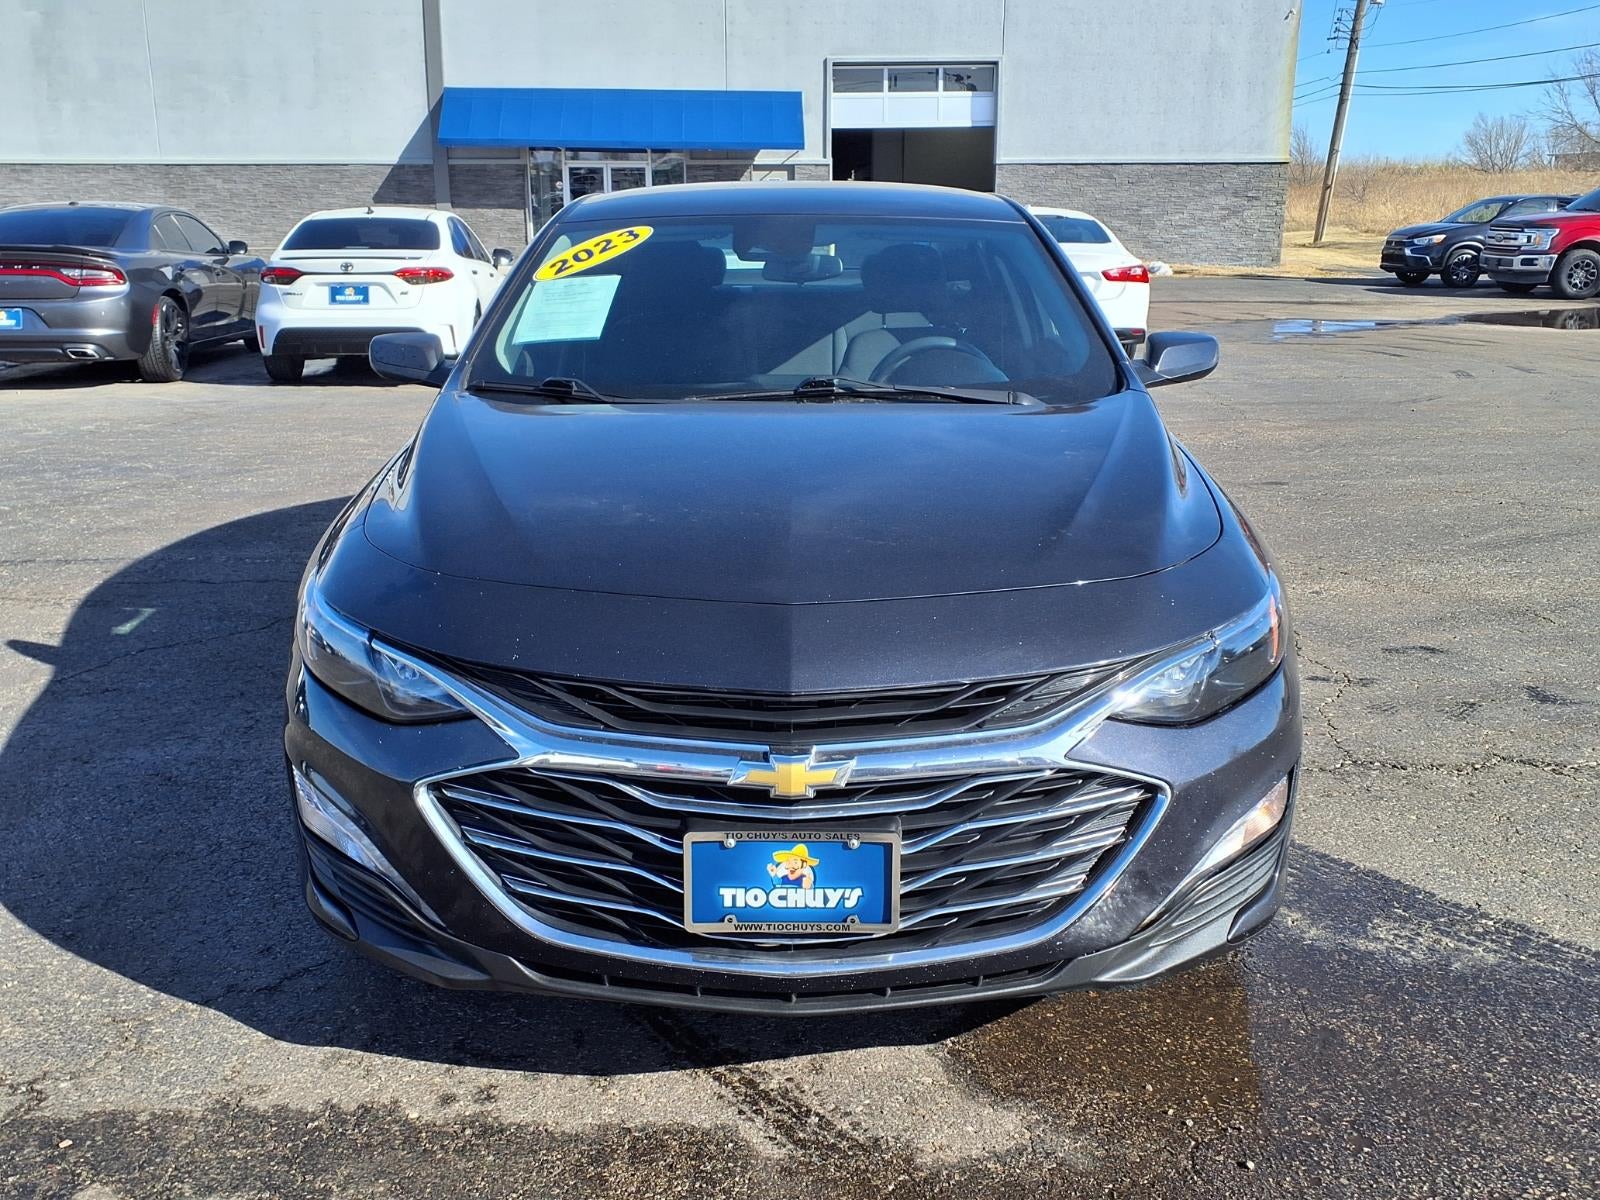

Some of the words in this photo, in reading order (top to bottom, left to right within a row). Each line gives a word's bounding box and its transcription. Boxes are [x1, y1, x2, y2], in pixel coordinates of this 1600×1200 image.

[549, 229, 640, 276] 2023
[724, 832, 743, 840] TIO
[746, 832, 788, 840] CHUY'S
[791, 832, 821, 840] AUTO
[825, 832, 860, 841] SALES
[719, 887, 767, 908] TIO
[768, 887, 863, 908] CHUY'S
[734, 923, 850, 932] WWW.TIOCHUYS.COM
